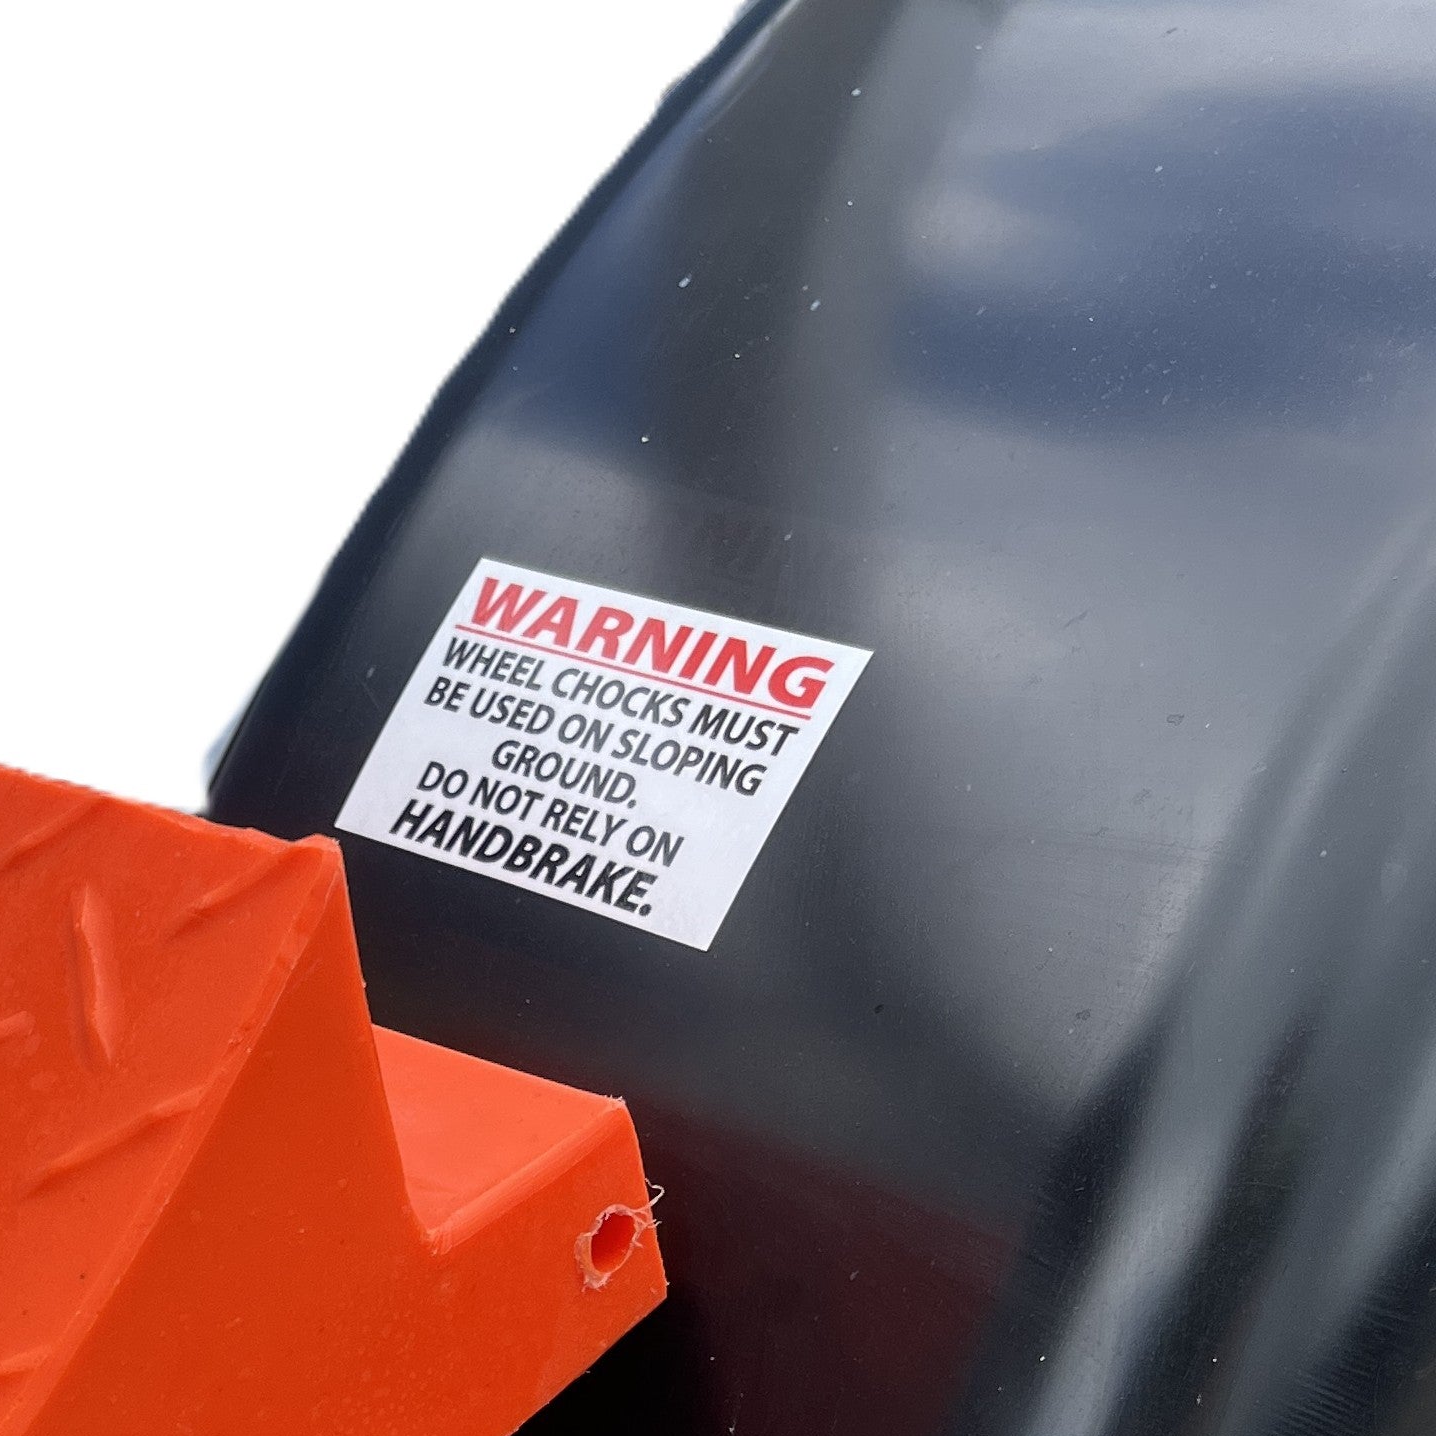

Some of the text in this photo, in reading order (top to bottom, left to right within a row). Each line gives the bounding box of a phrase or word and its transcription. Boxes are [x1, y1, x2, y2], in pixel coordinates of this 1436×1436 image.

[442, 637, 799, 756] WHEEL CHOCKS MUST
[471, 577, 834, 709] WARNING
[424, 676, 767, 796] BE USED ON SLOPING
[492, 740, 637, 809] GROUND.
[388, 799, 658, 917] HANDBRAKE.
[417, 761, 685, 868] DO NOT RELY ON
